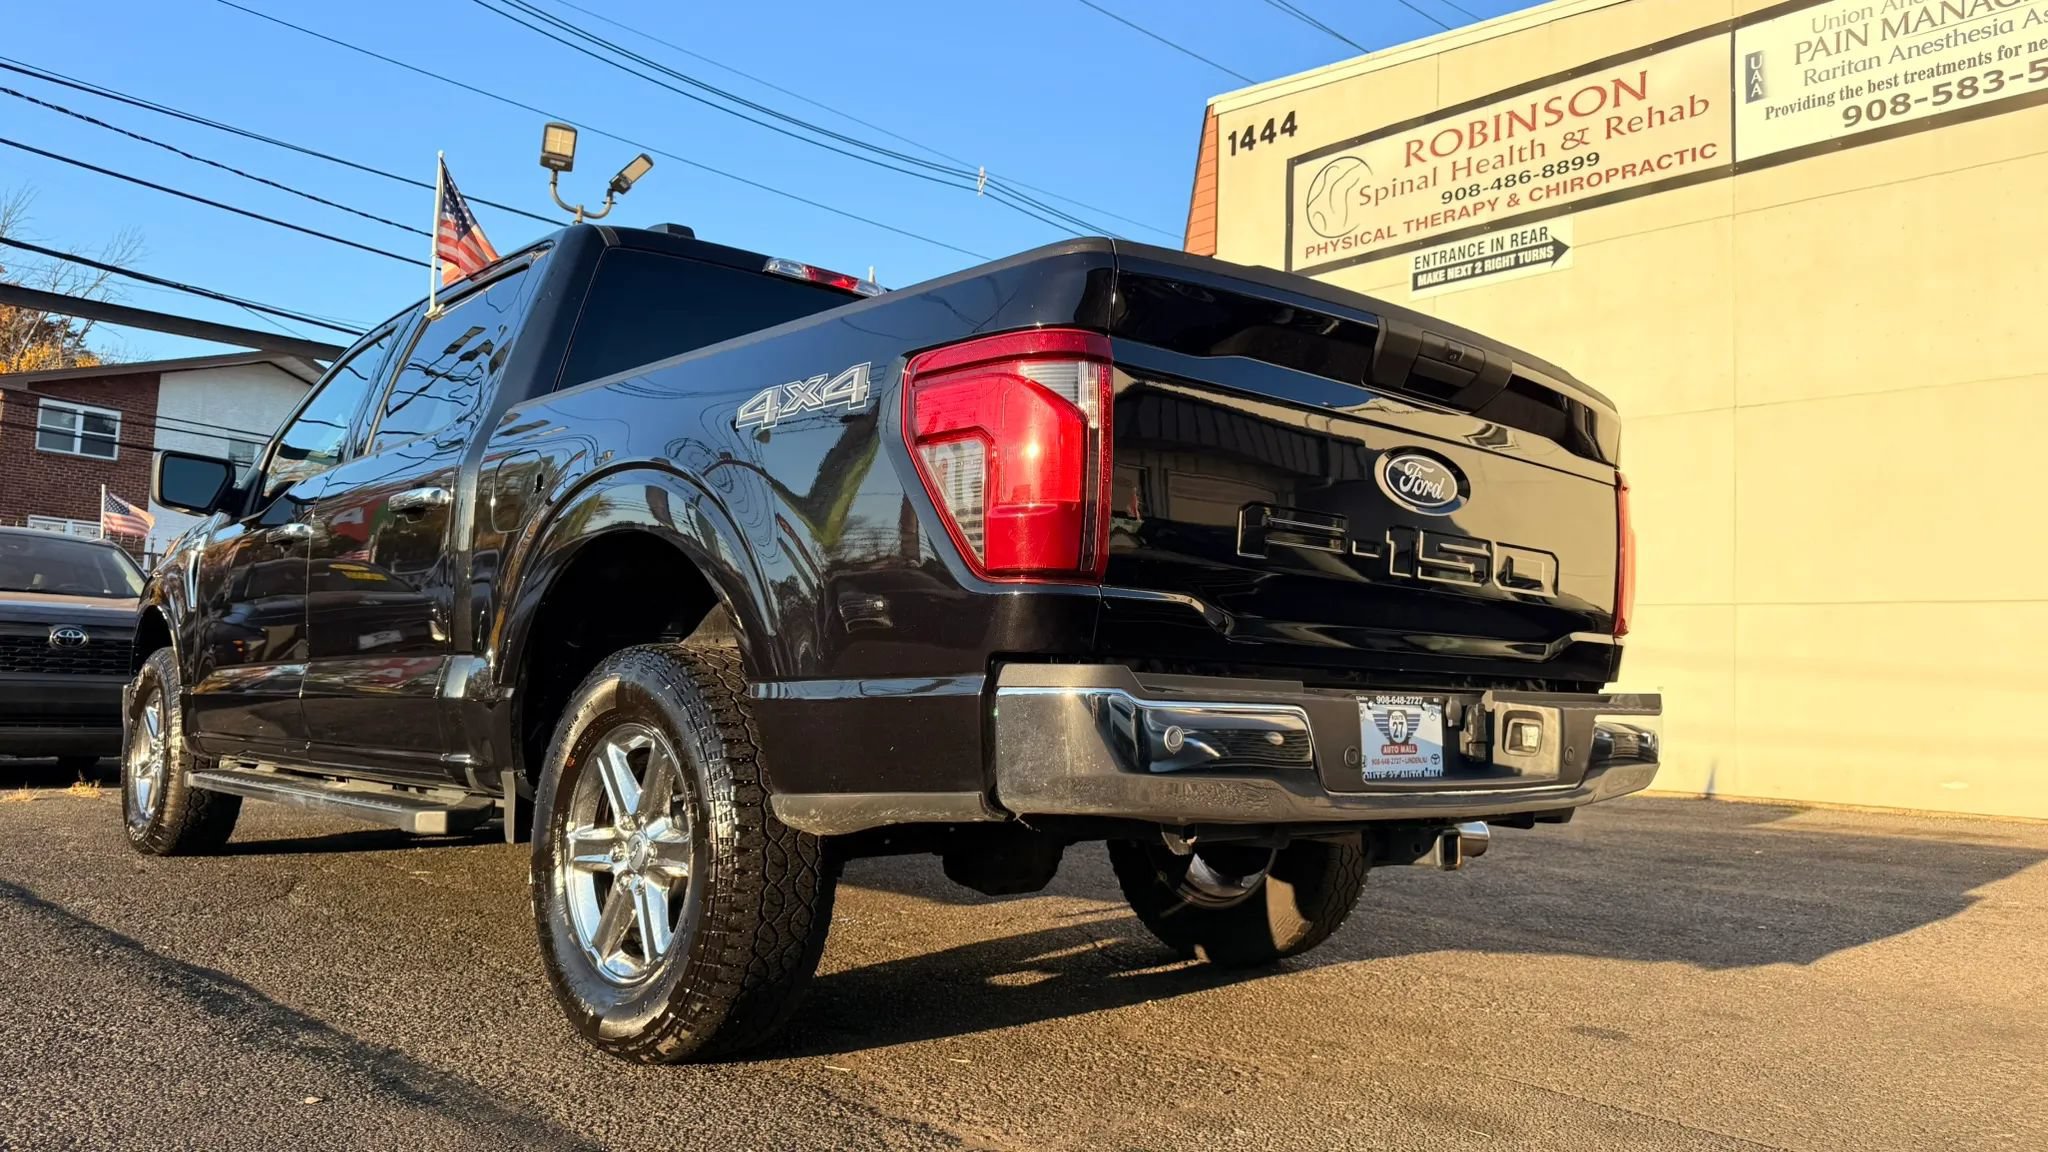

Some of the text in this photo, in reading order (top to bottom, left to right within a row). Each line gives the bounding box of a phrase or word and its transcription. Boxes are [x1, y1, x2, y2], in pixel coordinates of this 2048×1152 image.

[1794, 0, 2028, 65] PAIN MANA
[1812, 0, 1925, 34] Union An
[1804, 55, 1881, 87] Raritan
[1888, 18, 2015, 65] Anesthesia
[1764, 91, 1836, 121] Providing
[1839, 85, 1863, 101] the
[1867, 72, 1899, 94] best
[1903, 51, 1992, 85] treatments
[1997, 44, 2022, 61] for
[1842, 57, 2048, 128] 908-583-5
[1228, 111, 1298, 156] 1444
[1404, 70, 1648, 168] ROBINSON
[1359, 94, 1710, 207] Spinal Health & Rehab
[1305, 143, 1718, 259] PHYSICAL THERAPY & CHIROPRACTIC
[1441, 151, 1600, 205] 908-486-8899
[1414, 226, 1548, 270] ENTRANCE IN REAR
[1417, 245, 1554, 287] MAKE NEXT 2 RIGHT TURNS
[1399, 460, 1446, 500] Ford
[1236, 502, 1559, 598] F-150
[1376, 695, 1424, 705] 908-648-2727
[1383, 744, 1416, 754] AUTO MALL
[1392, 721, 1404, 738] 27
